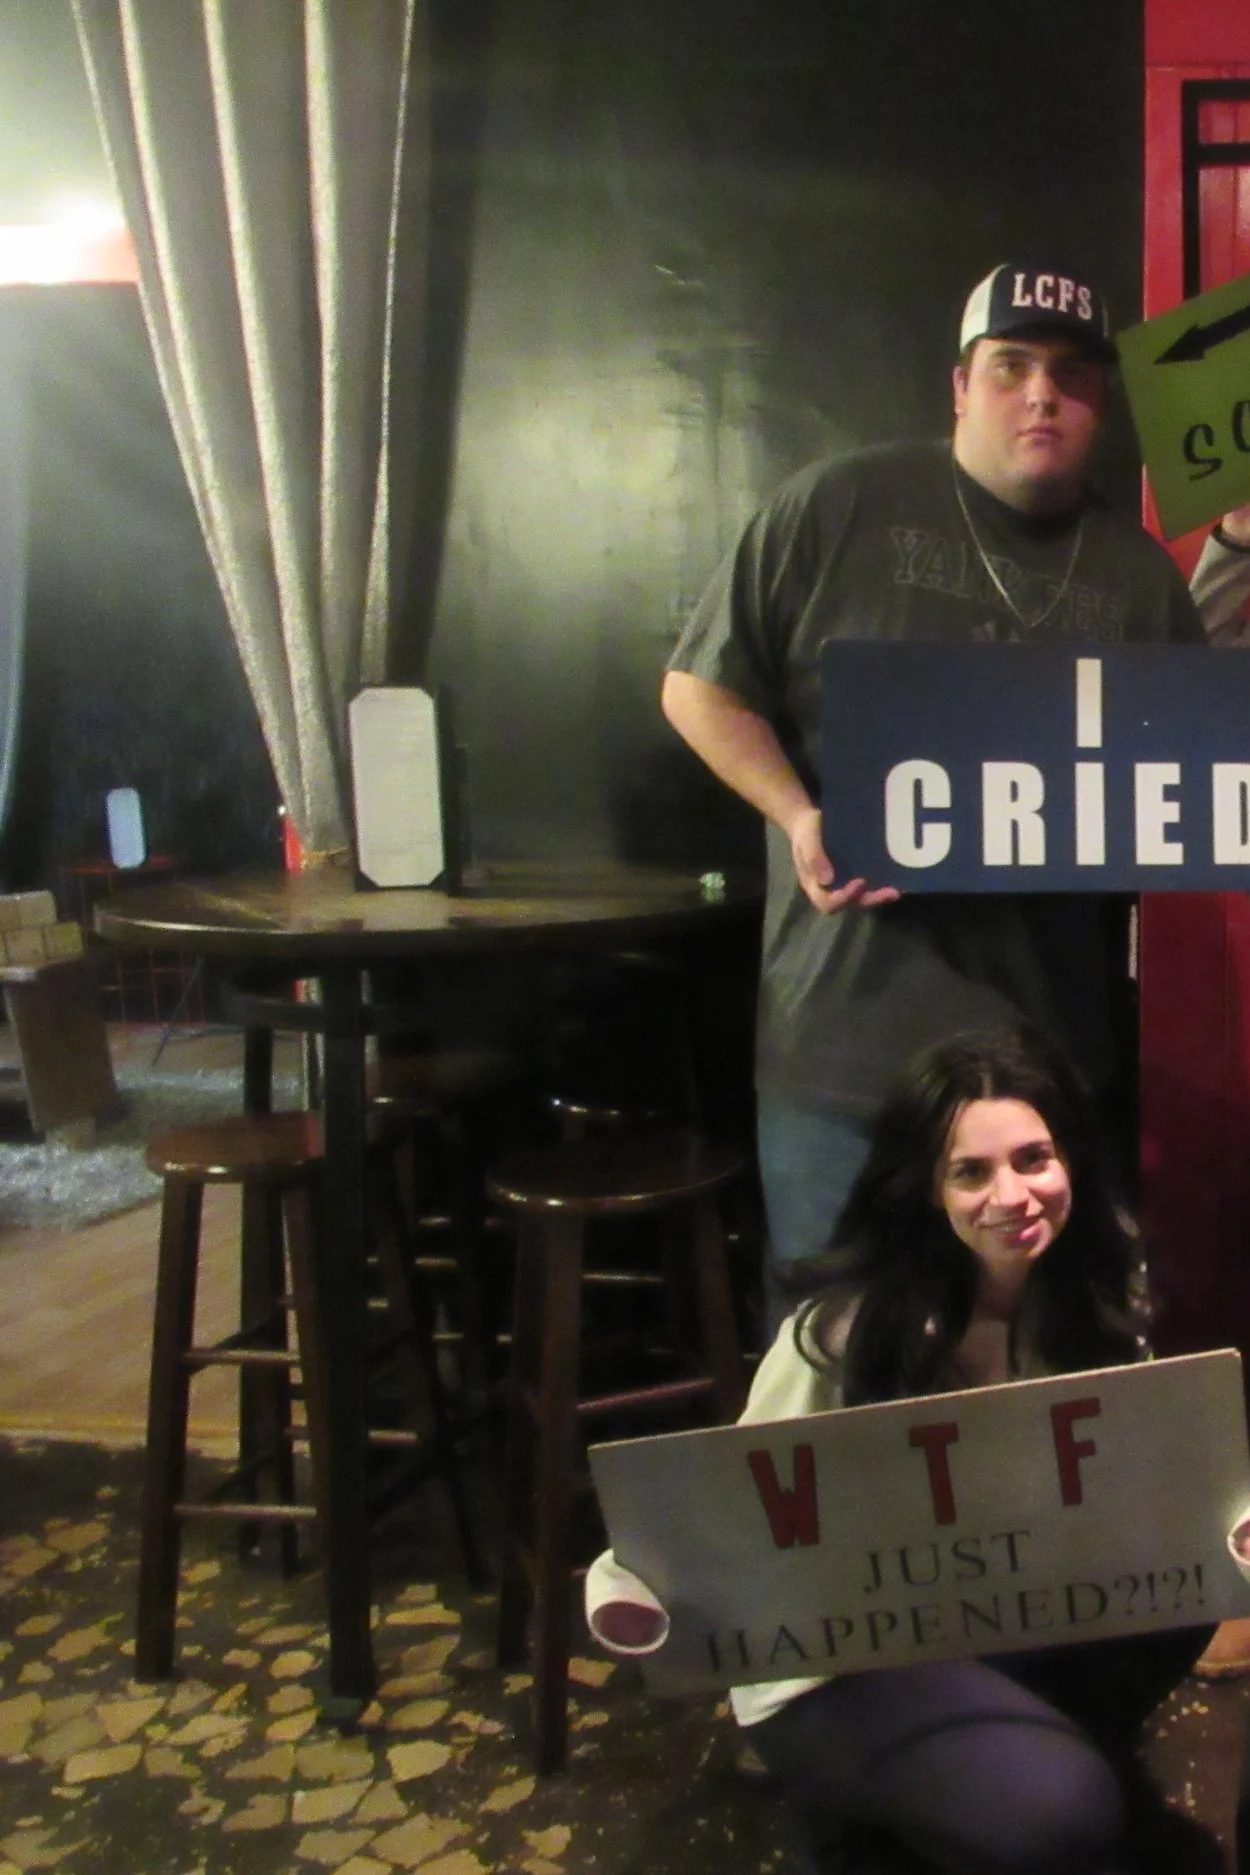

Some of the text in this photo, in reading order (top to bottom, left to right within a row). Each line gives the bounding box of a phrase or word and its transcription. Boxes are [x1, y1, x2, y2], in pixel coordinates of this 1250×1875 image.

[1011, 271, 1093, 321] LCFS
[1075, 658, 1103, 748] I
[863, 1530, 1031, 1594] JUST
[704, 1563, 1207, 1673] HAPPENED?!?!
